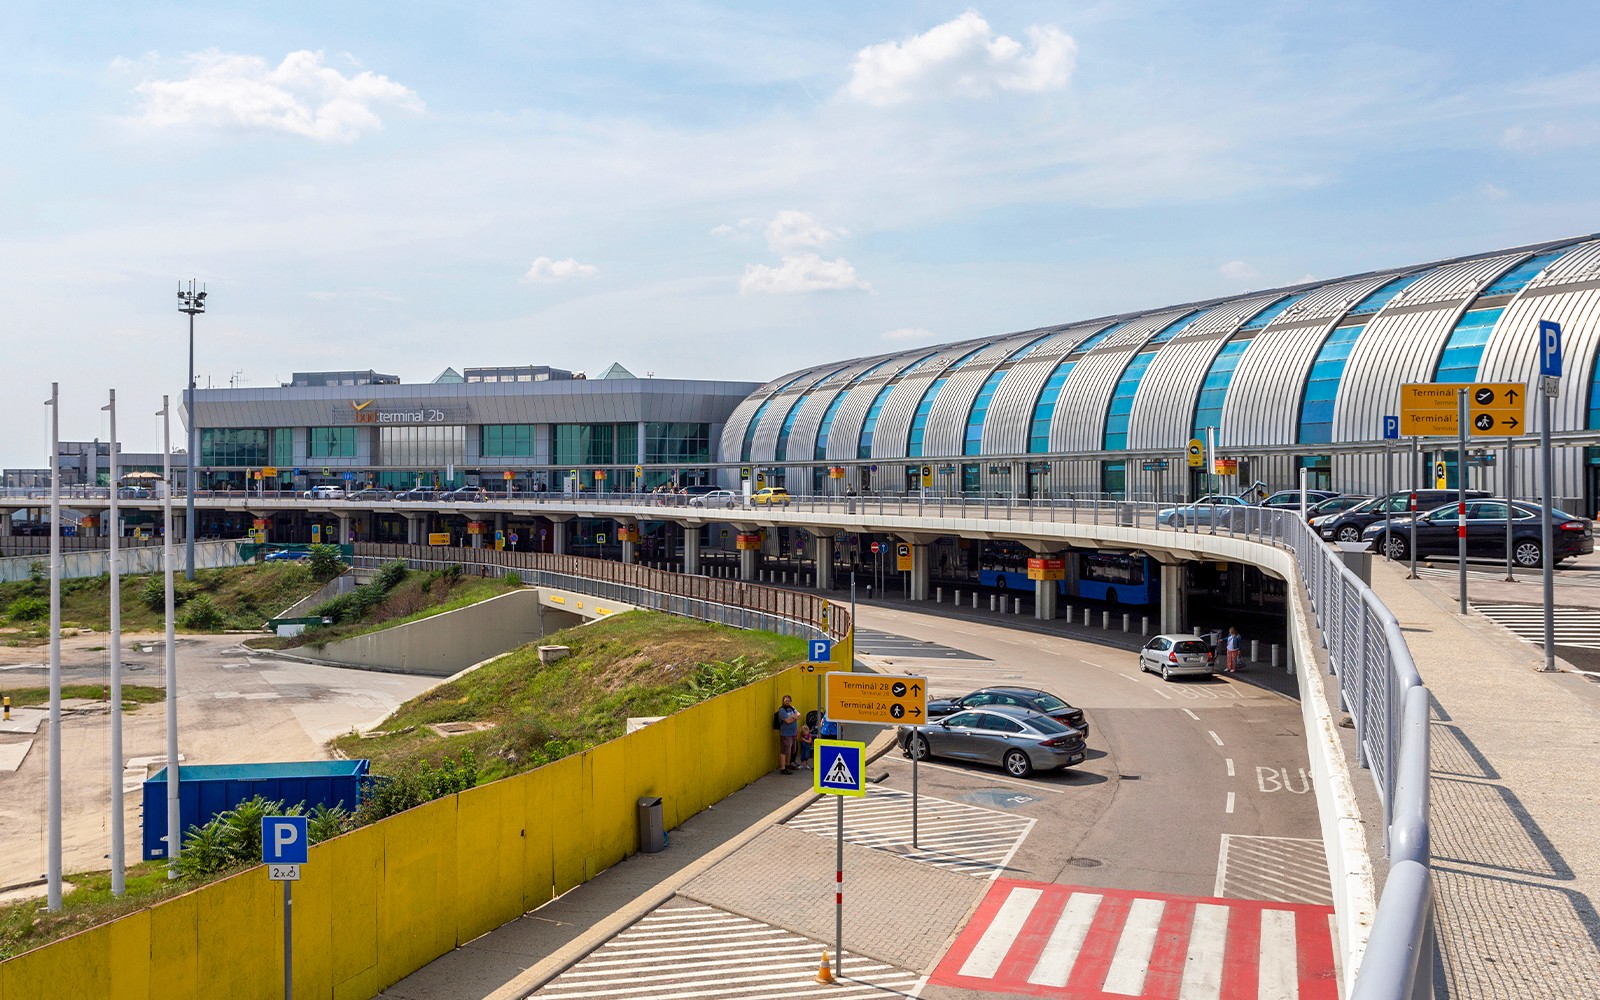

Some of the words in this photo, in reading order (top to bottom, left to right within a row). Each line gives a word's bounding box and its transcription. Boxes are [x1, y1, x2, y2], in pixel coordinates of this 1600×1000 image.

[1545, 328, 1557, 369] P
[1412, 388, 1454, 397] Terminál
[428, 409, 445, 423] 2b
[1411, 414, 1452, 423] Terminál
[1387, 419, 1396, 436] P
[814, 642, 826, 659] P
[843, 681, 877, 690] Terminál
[840, 700, 874, 710] Terminál
[1255, 766, 1313, 794] BU
[274, 823, 298, 857] P
